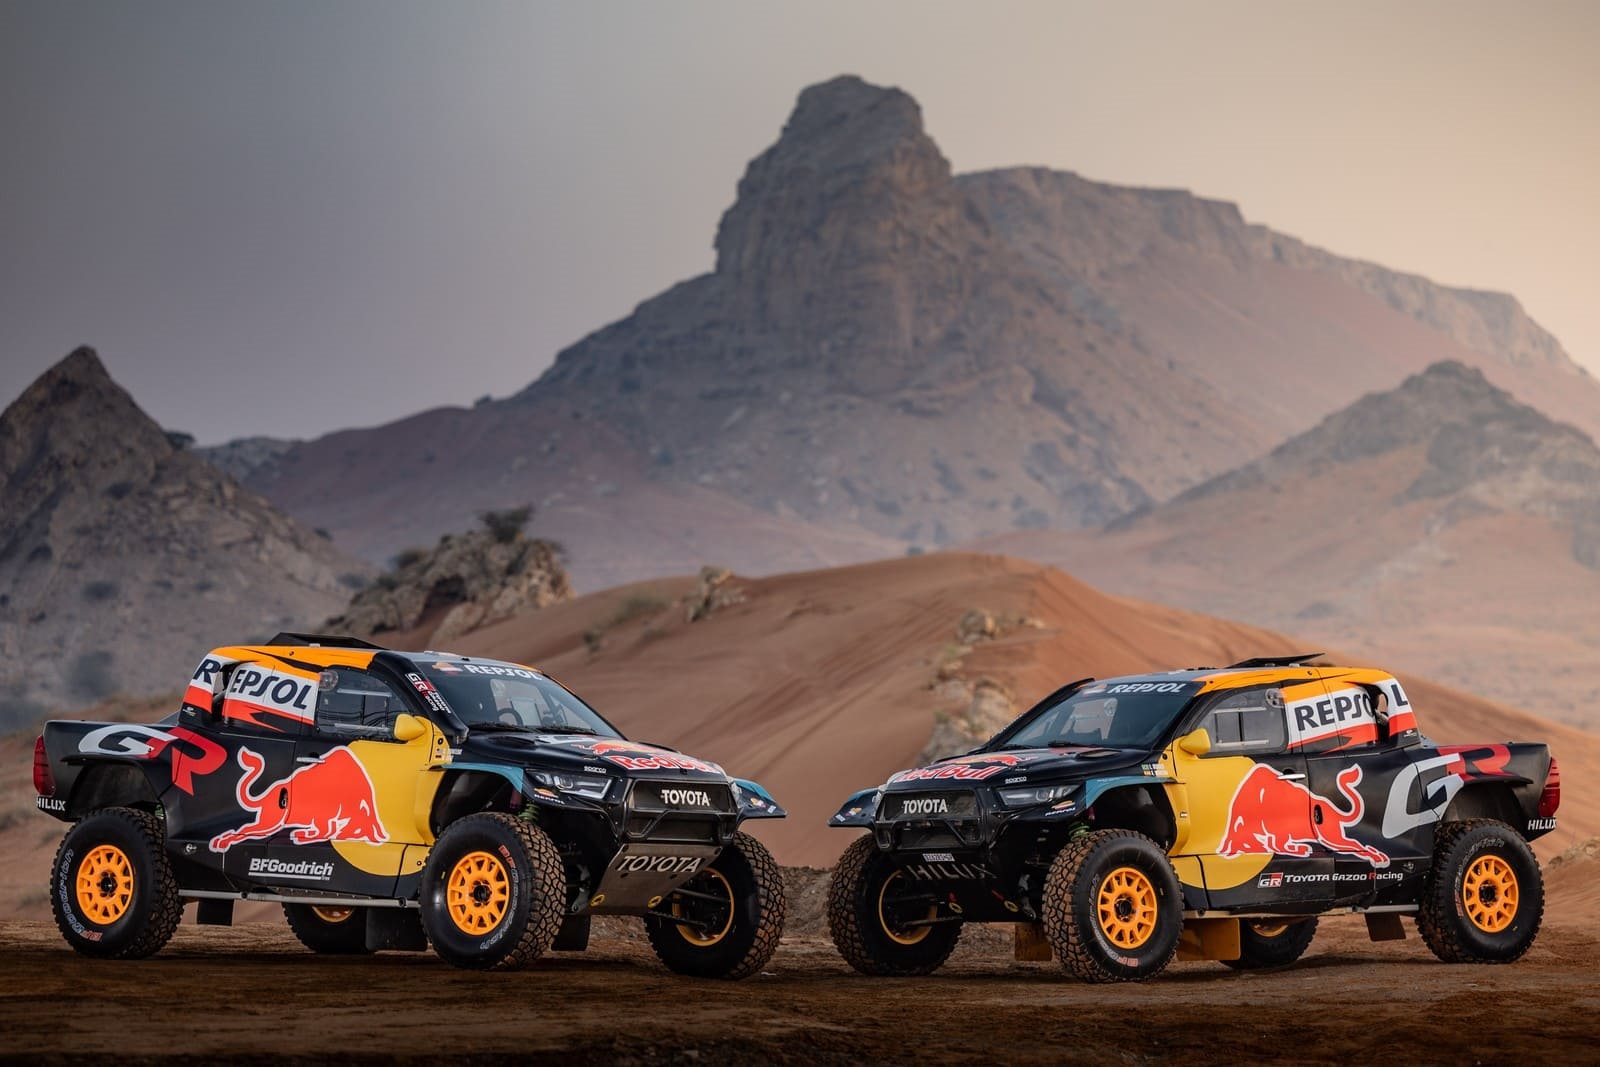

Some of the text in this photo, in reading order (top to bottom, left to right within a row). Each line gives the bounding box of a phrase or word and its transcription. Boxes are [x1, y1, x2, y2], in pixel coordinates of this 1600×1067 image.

[463, 664, 542, 680] REPSOL
[1107, 683, 1187, 693] REPSOL
[78, 724, 227, 796] GR
[661, 789, 710, 807] TOYOTA
[1382, 744, 1516, 839] GR
[903, 799, 948, 814] TOYOTA
[1528, 819, 1558, 830] HILUX
[249, 858, 334, 876] BFGoodrich
[617, 855, 702, 873] TOYOTA
[1259, 872, 1404, 888] GR TOYOTA GAZOO Racing
